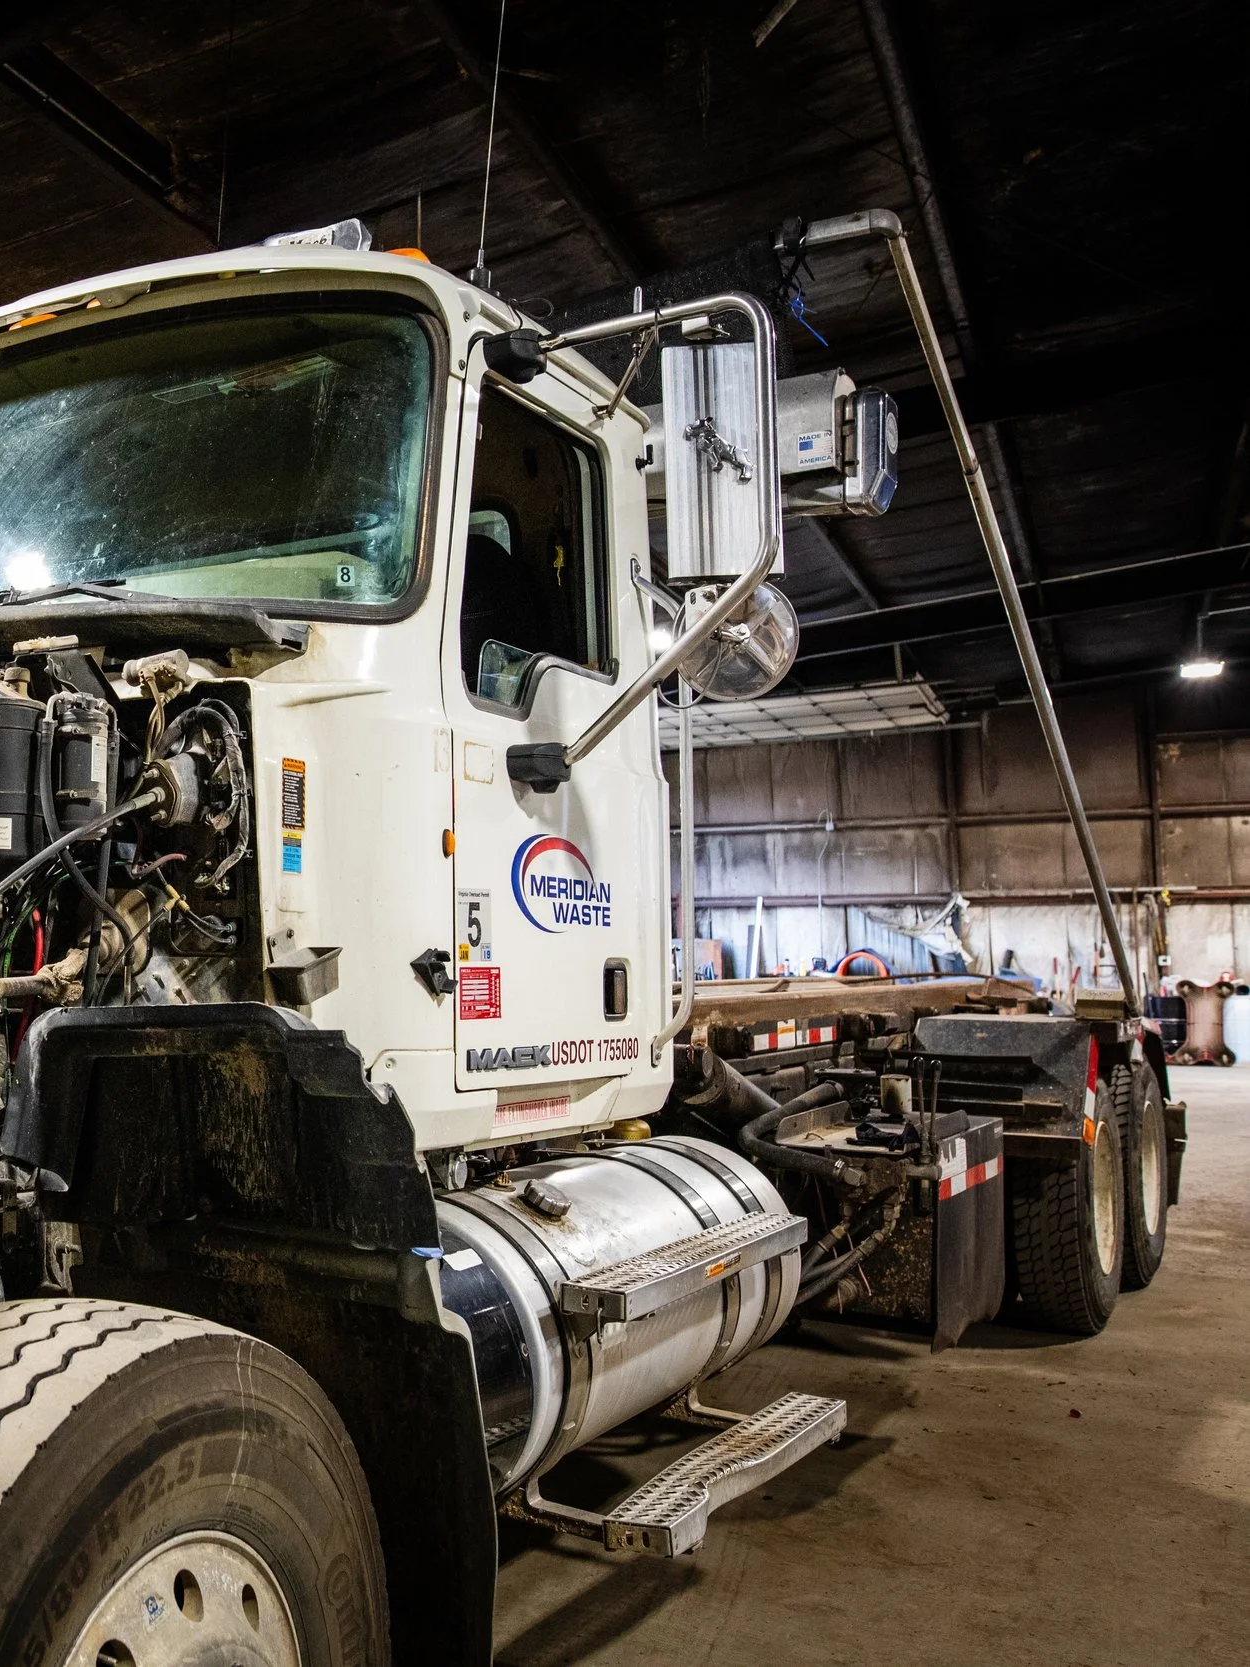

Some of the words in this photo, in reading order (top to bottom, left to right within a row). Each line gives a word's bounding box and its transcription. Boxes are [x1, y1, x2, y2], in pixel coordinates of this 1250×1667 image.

[798, 433, 822, 441] MADE
[799, 455, 832, 465] AMERICA
[340, 566, 351, 583] 8
[530, 874, 610, 903] MERIDIAN
[468, 902, 481, 947] 5
[552, 902, 610, 927] WASTE
[459, 950, 469, 960] JAN
[483, 950, 491, 959] 19
[467, 1045, 552, 1073] MACK
[551, 1040, 594, 1066] USDOT
[597, 1037, 639, 1061] 1755080
[495, 1107, 506, 1126] FIRE
[508, 1101, 548, 1123] EXTINGUISHER
[549, 1098, 568, 1117] INSIDE
